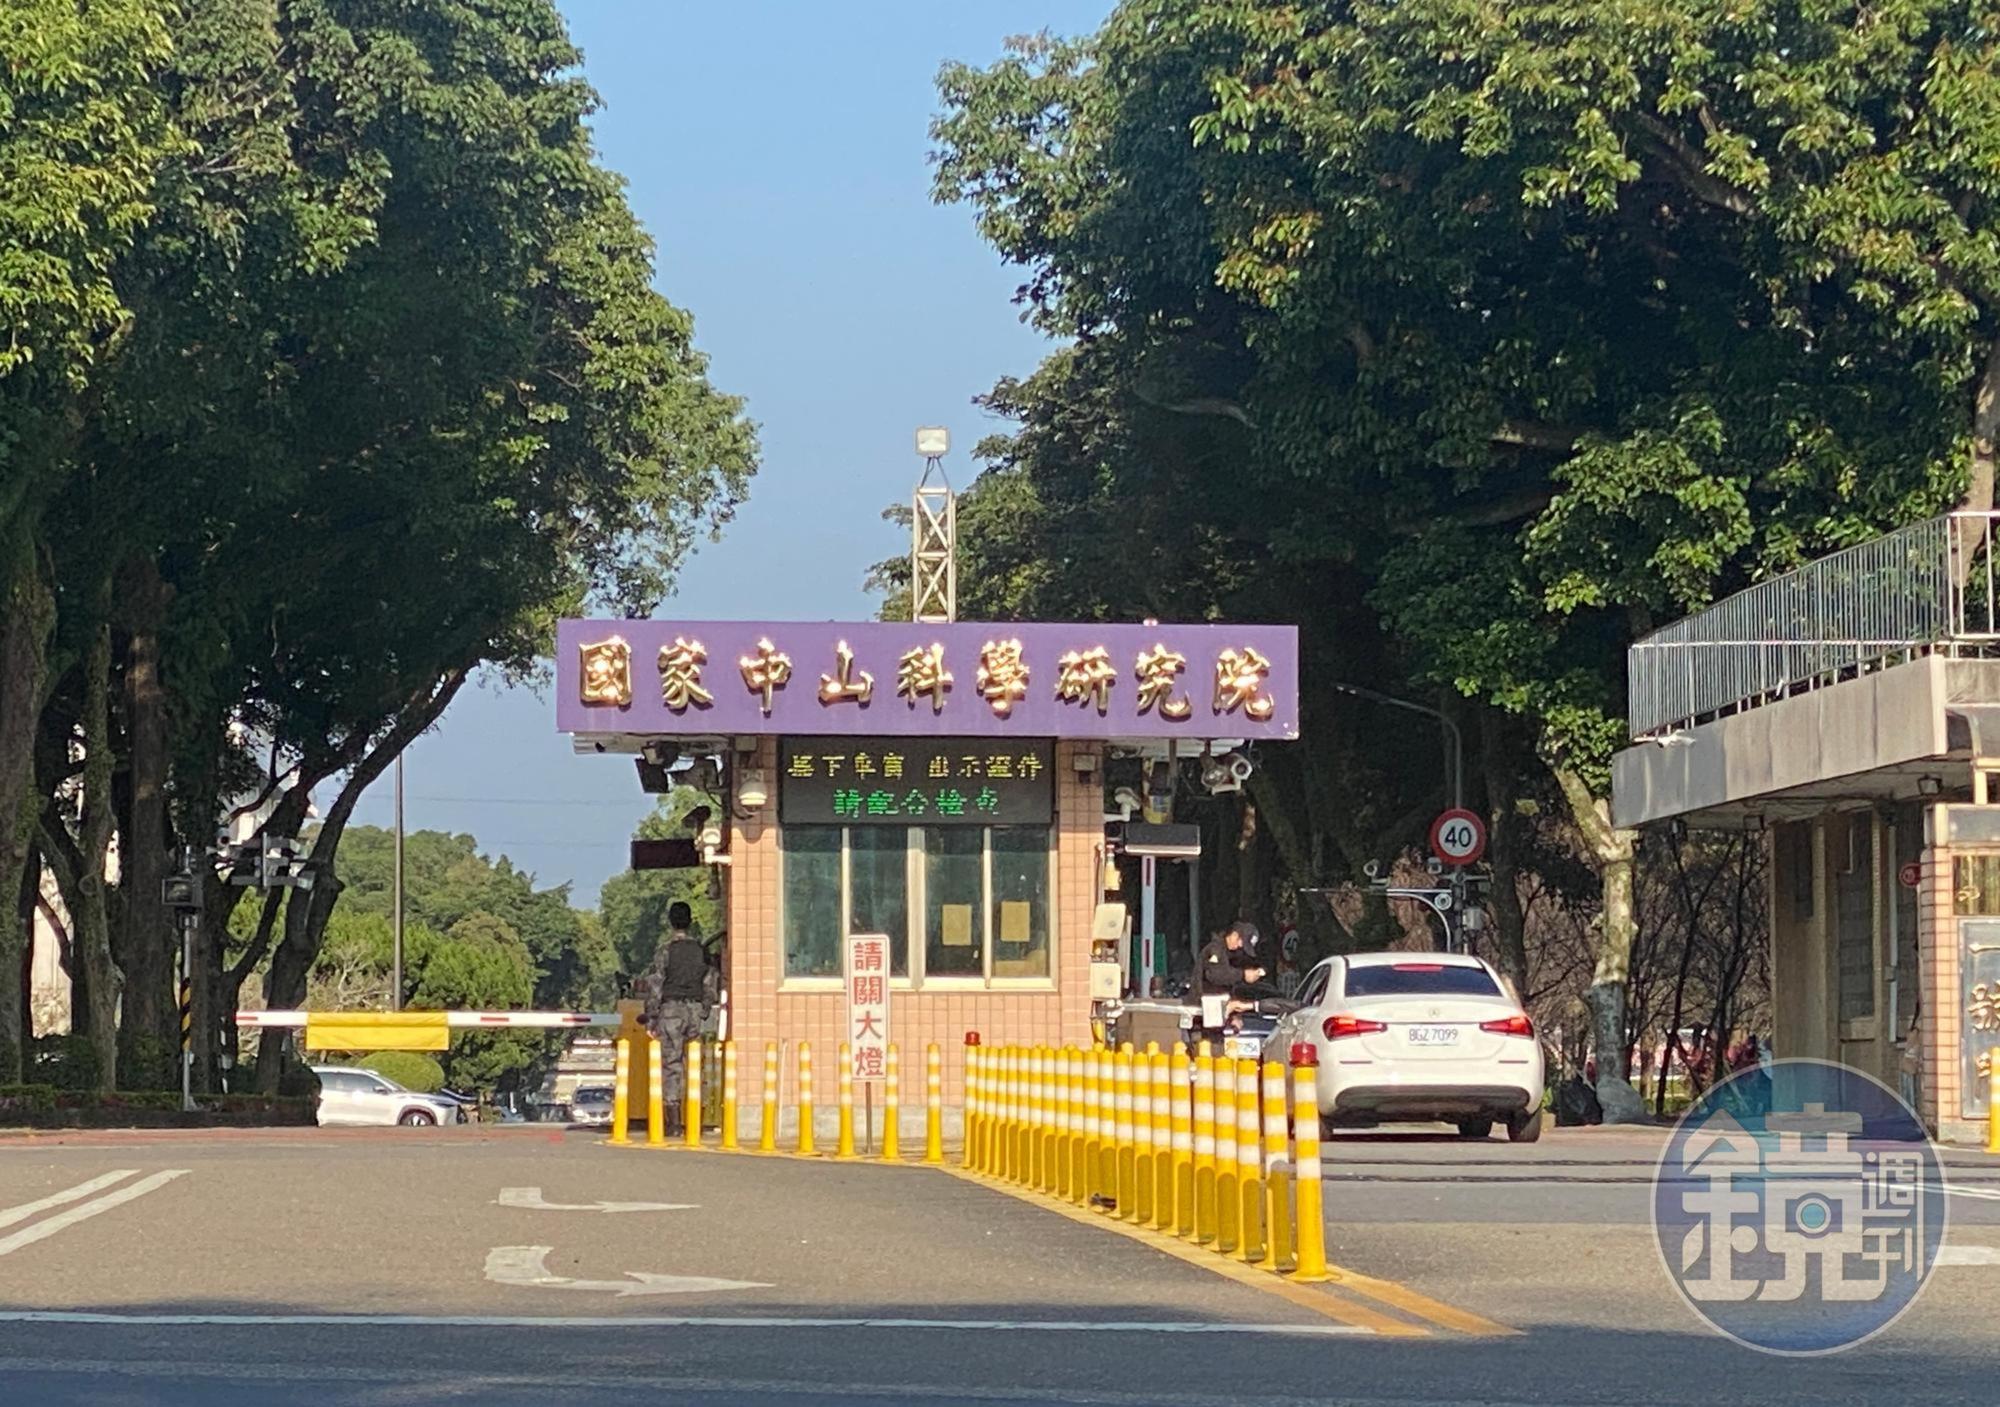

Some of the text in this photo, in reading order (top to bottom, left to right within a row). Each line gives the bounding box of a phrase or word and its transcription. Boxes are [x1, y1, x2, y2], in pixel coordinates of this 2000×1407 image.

[579, 635, 1273, 721] 國家中山科學研究院
[1444, 825, 1472, 848] 40
[854, 942, 883, 1076] 請關大燈
